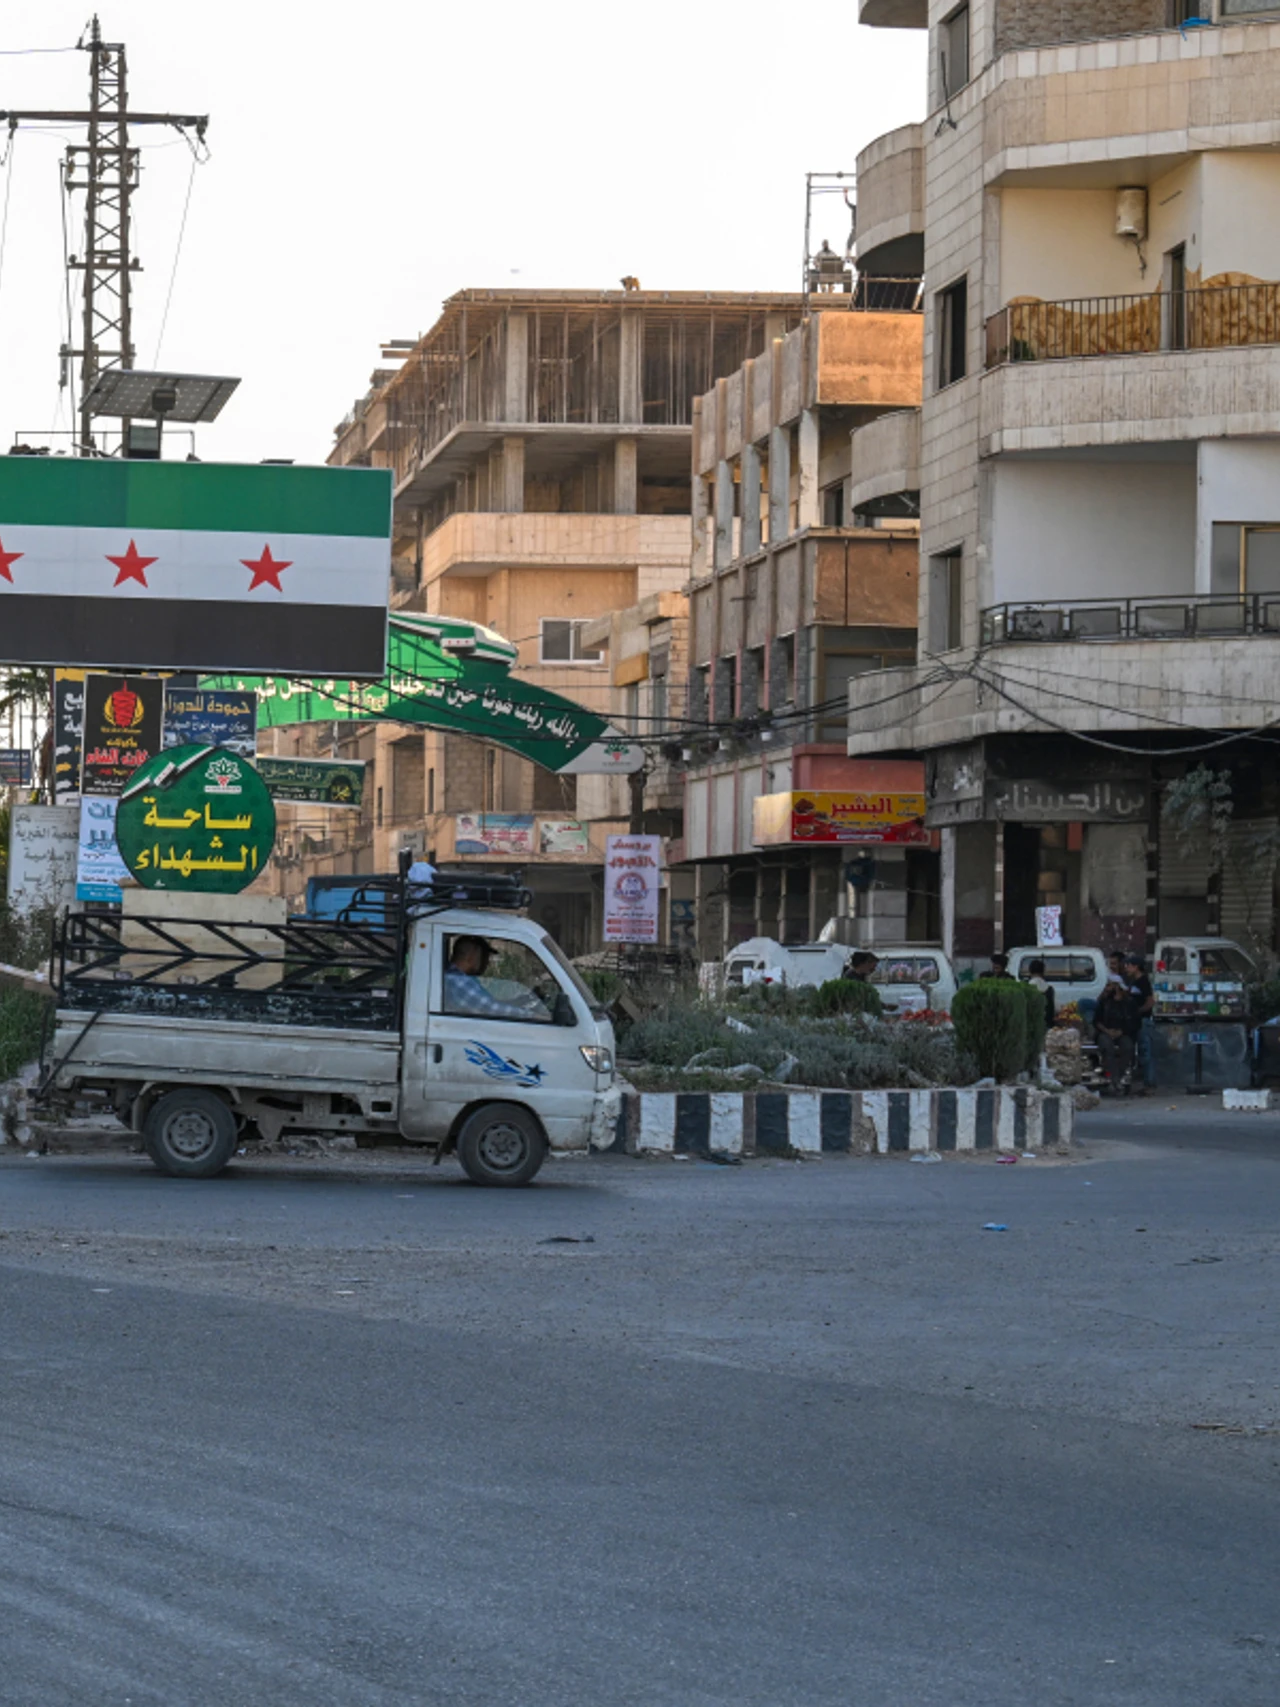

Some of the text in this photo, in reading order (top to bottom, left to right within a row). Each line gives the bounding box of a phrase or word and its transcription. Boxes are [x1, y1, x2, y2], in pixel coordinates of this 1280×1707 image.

[142, 796, 252, 829] ساحة
[830, 796, 892, 819] البشير
[134, 835, 258, 877] الشهداء
